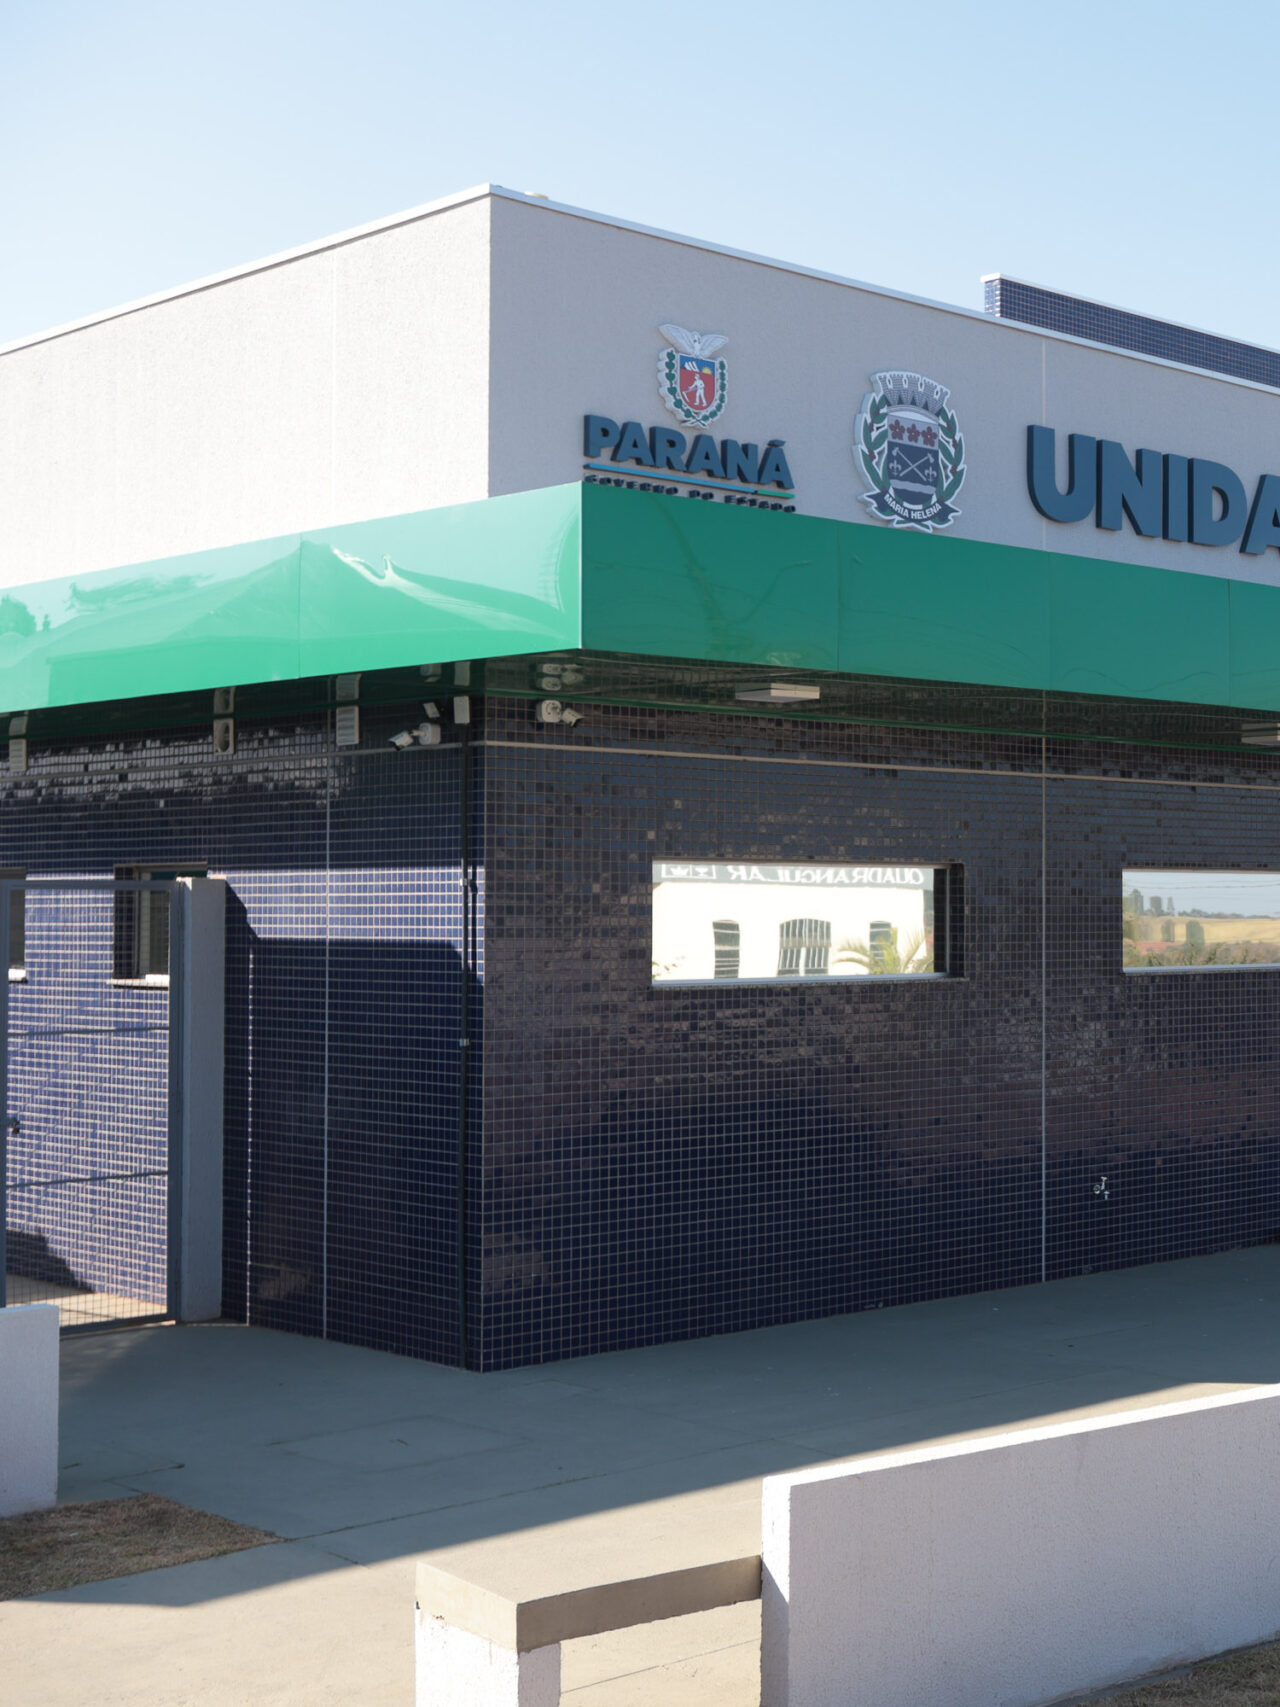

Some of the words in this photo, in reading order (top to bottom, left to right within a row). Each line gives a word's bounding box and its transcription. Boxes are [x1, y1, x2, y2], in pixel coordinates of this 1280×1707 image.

[583, 414, 796, 489] PARANÁ
[884, 494, 909, 517] MARIA
[911, 503, 942, 519] HELENA
